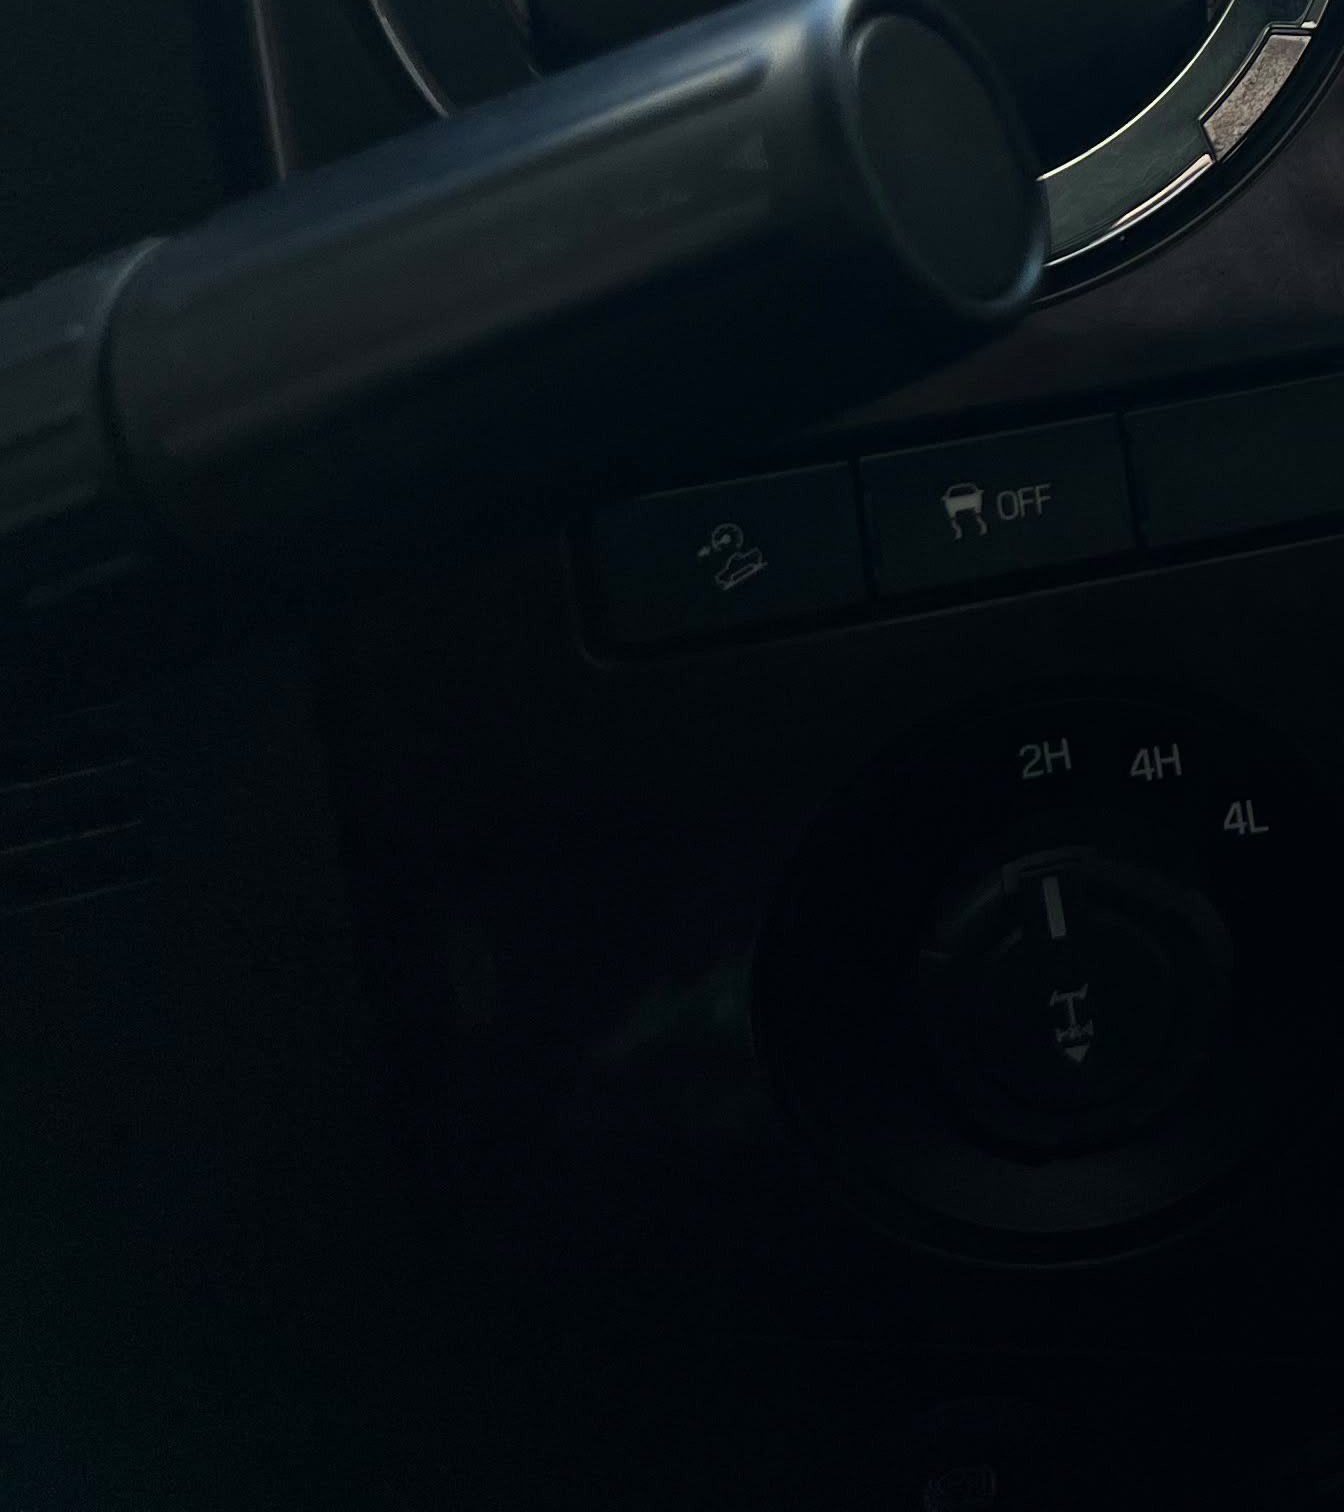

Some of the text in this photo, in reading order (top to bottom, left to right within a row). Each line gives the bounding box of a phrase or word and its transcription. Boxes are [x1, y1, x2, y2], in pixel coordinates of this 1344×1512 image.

[996, 482, 1053, 522] OFF
[1017, 737, 1073, 780] 2H
[1129, 742, 1184, 783] 4H
[1222, 798, 1271, 836] 4L
